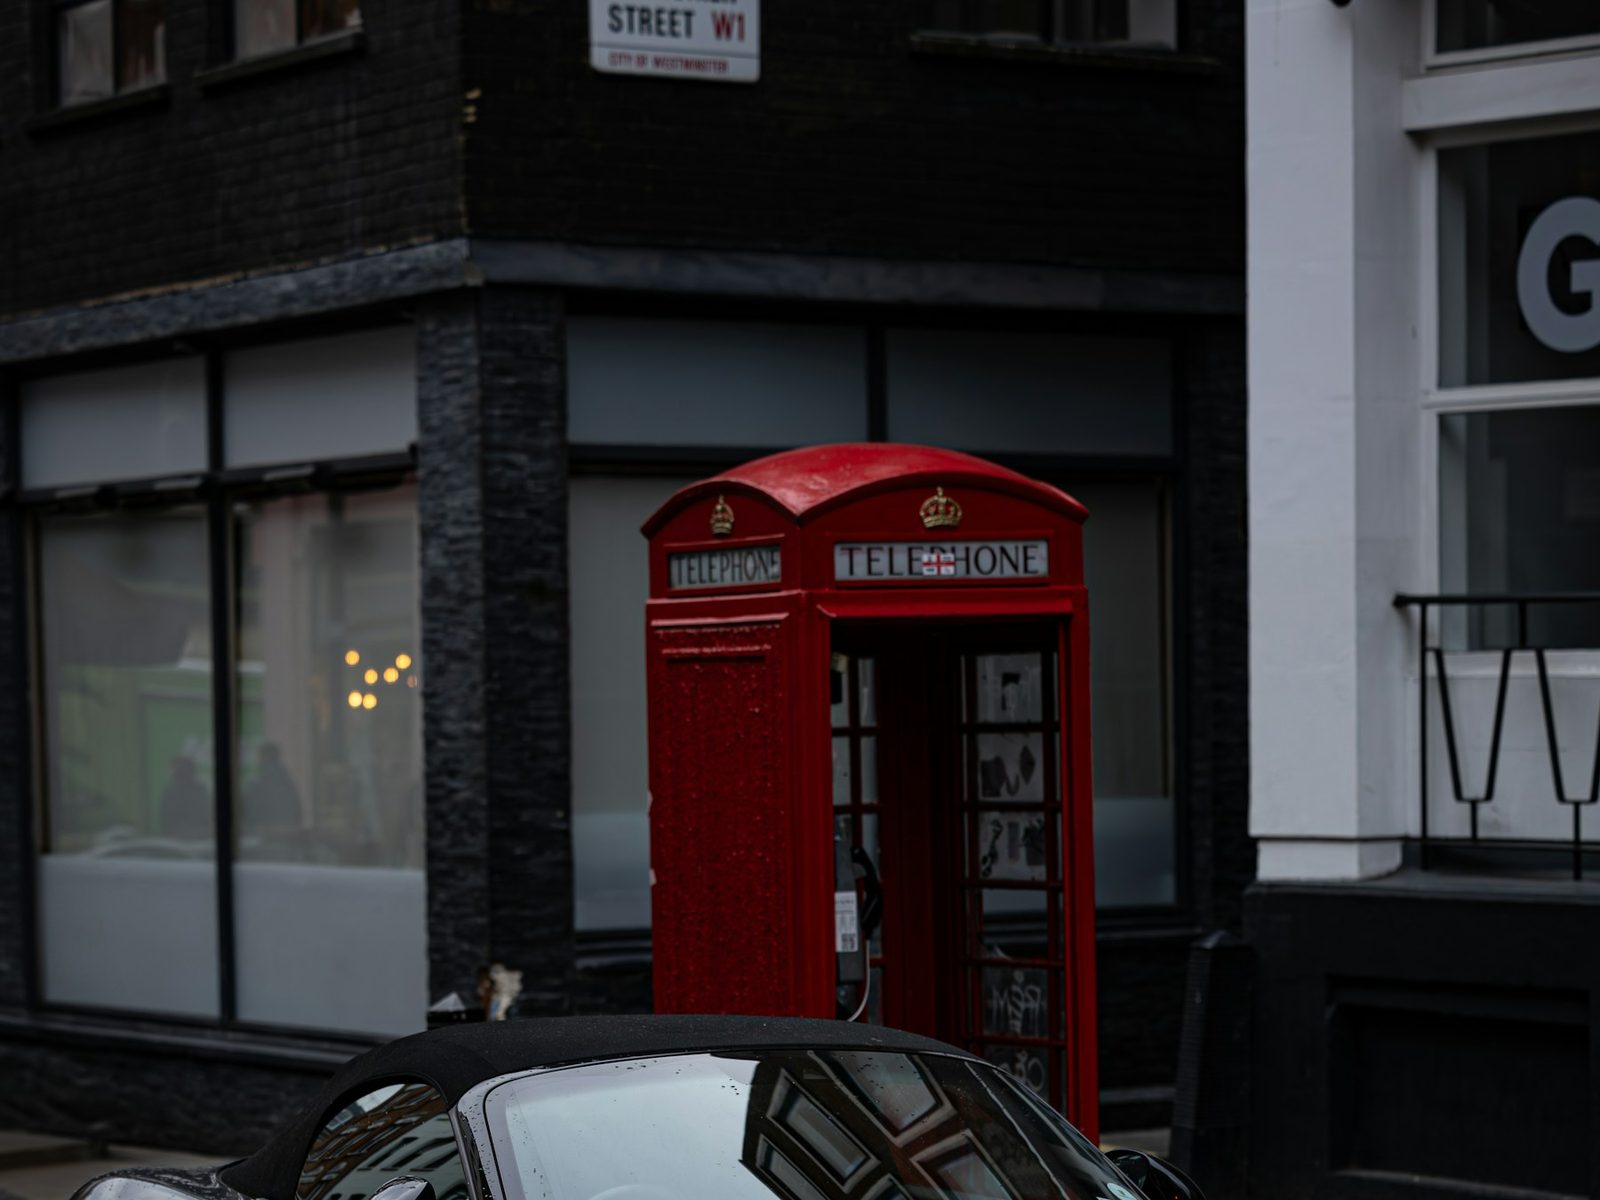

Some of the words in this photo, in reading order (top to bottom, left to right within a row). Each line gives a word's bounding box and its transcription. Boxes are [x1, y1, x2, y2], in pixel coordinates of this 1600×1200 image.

[607, 5, 695, 38] STREET
[711, 11, 745, 41] W1
[608, 52, 632, 66] CITY
[654, 56, 729, 73] WESTMINSTER
[673, 550, 779, 585] TELEPHONE
